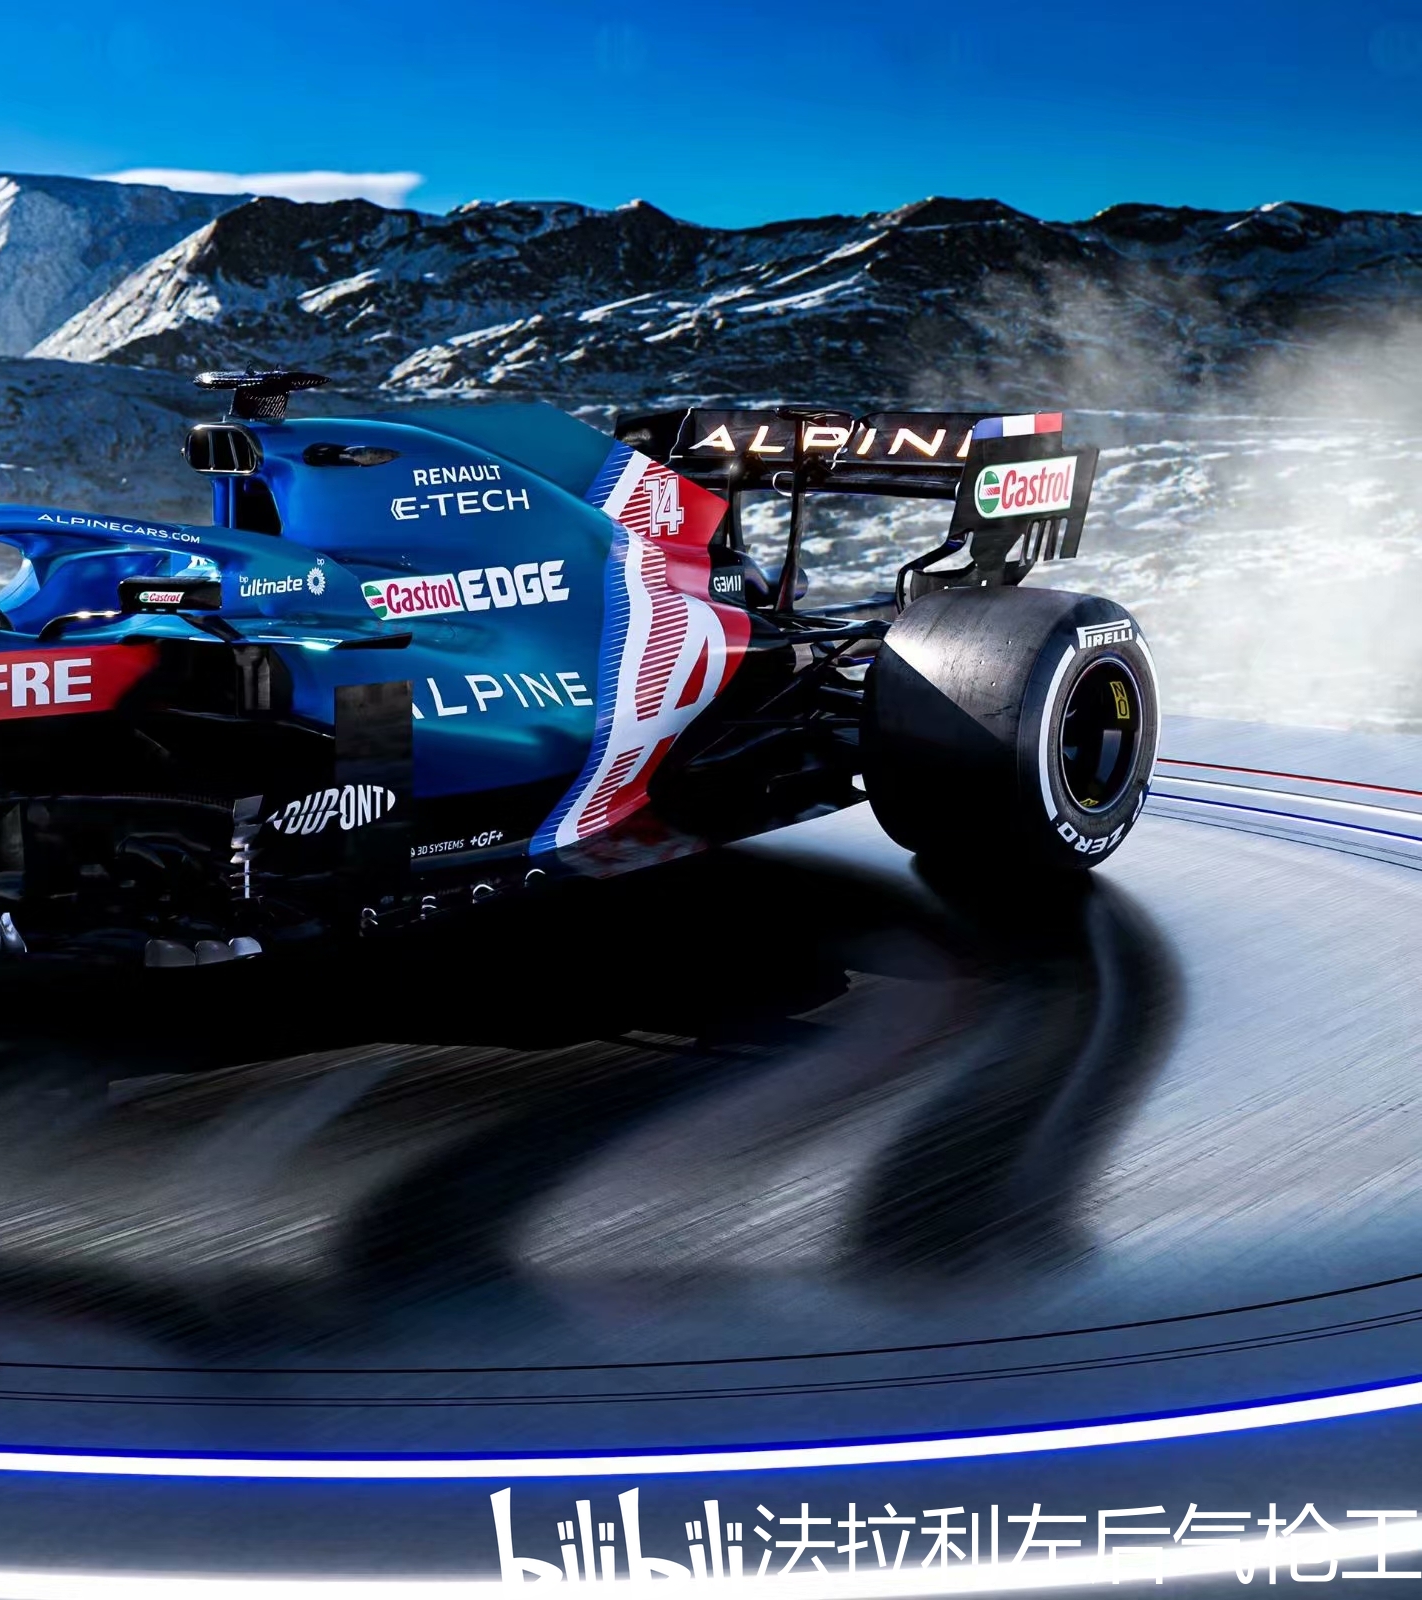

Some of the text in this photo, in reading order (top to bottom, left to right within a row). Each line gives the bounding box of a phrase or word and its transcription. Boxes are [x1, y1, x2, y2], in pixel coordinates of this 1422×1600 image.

[689, 424, 973, 458] ALPIN
[413, 465, 501, 486] RENAULT
[1002, 464, 1071, 510] Castrol
[391, 489, 530, 520] E-TECH
[642, 475, 685, 537] 14
[38, 514, 200, 543] ALPINECARS.COM
[317, 557, 325, 567] bp
[239, 574, 249, 584] bp
[241, 575, 303, 597] ultimate
[386, 560, 570, 614] Castrol EDGE
[149, 593, 181, 602] Castrol
[1076, 618, 1133, 649] PIRELLI
[284, 784, 385, 835] DUPONT
[417, 839, 466, 856] 3D SYSTEMS
[1057, 821, 1126, 855] ZERO
